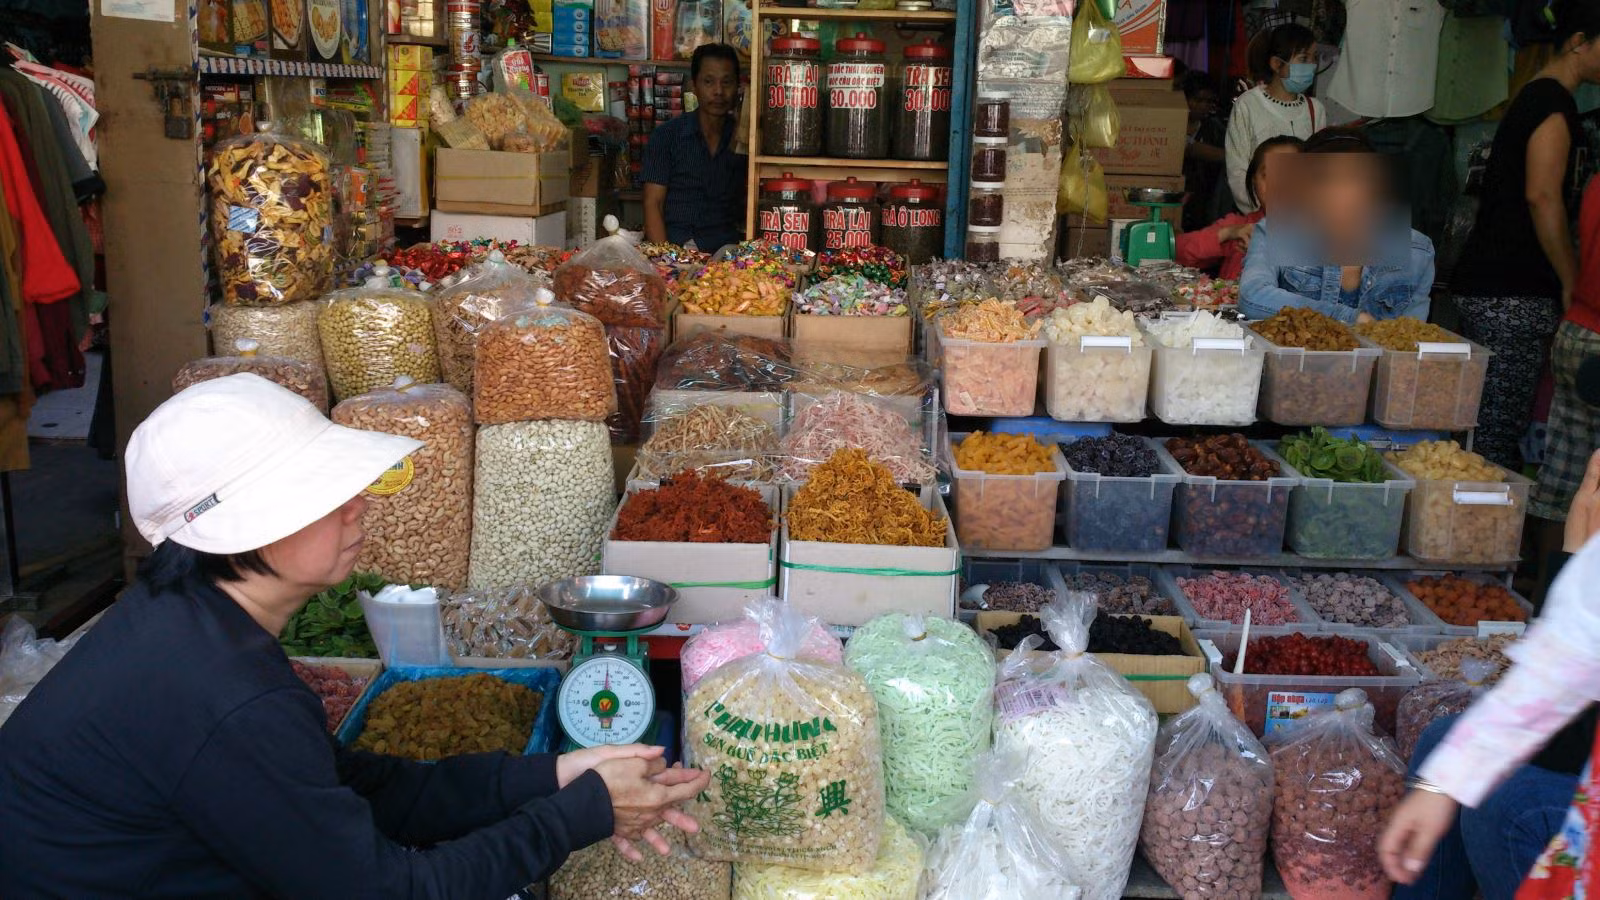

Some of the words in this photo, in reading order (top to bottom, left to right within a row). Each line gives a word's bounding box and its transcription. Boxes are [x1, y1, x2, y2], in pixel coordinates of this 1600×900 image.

[932, 66, 950, 86] SE
[769, 85, 818, 108] 30.000
[830, 89, 876, 108] 30.000
[904, 88, 950, 112] 30.00
[760, 206, 782, 232] TRÀ
[783, 212, 809, 233] SEN
[823, 205, 846, 231] TRÀ
[849, 206, 871, 231] LÀI
[881, 205, 897, 227] TRÀ
[897, 205, 908, 228] Ô
[911, 208, 941, 227] LONG
[763, 230, 808, 249] 25000
[826, 230, 871, 249] 25.000
[193, 497, 214, 515] SPORT
[797, 741, 829, 761] BIỆT
[815, 779, 851, 819] 興
